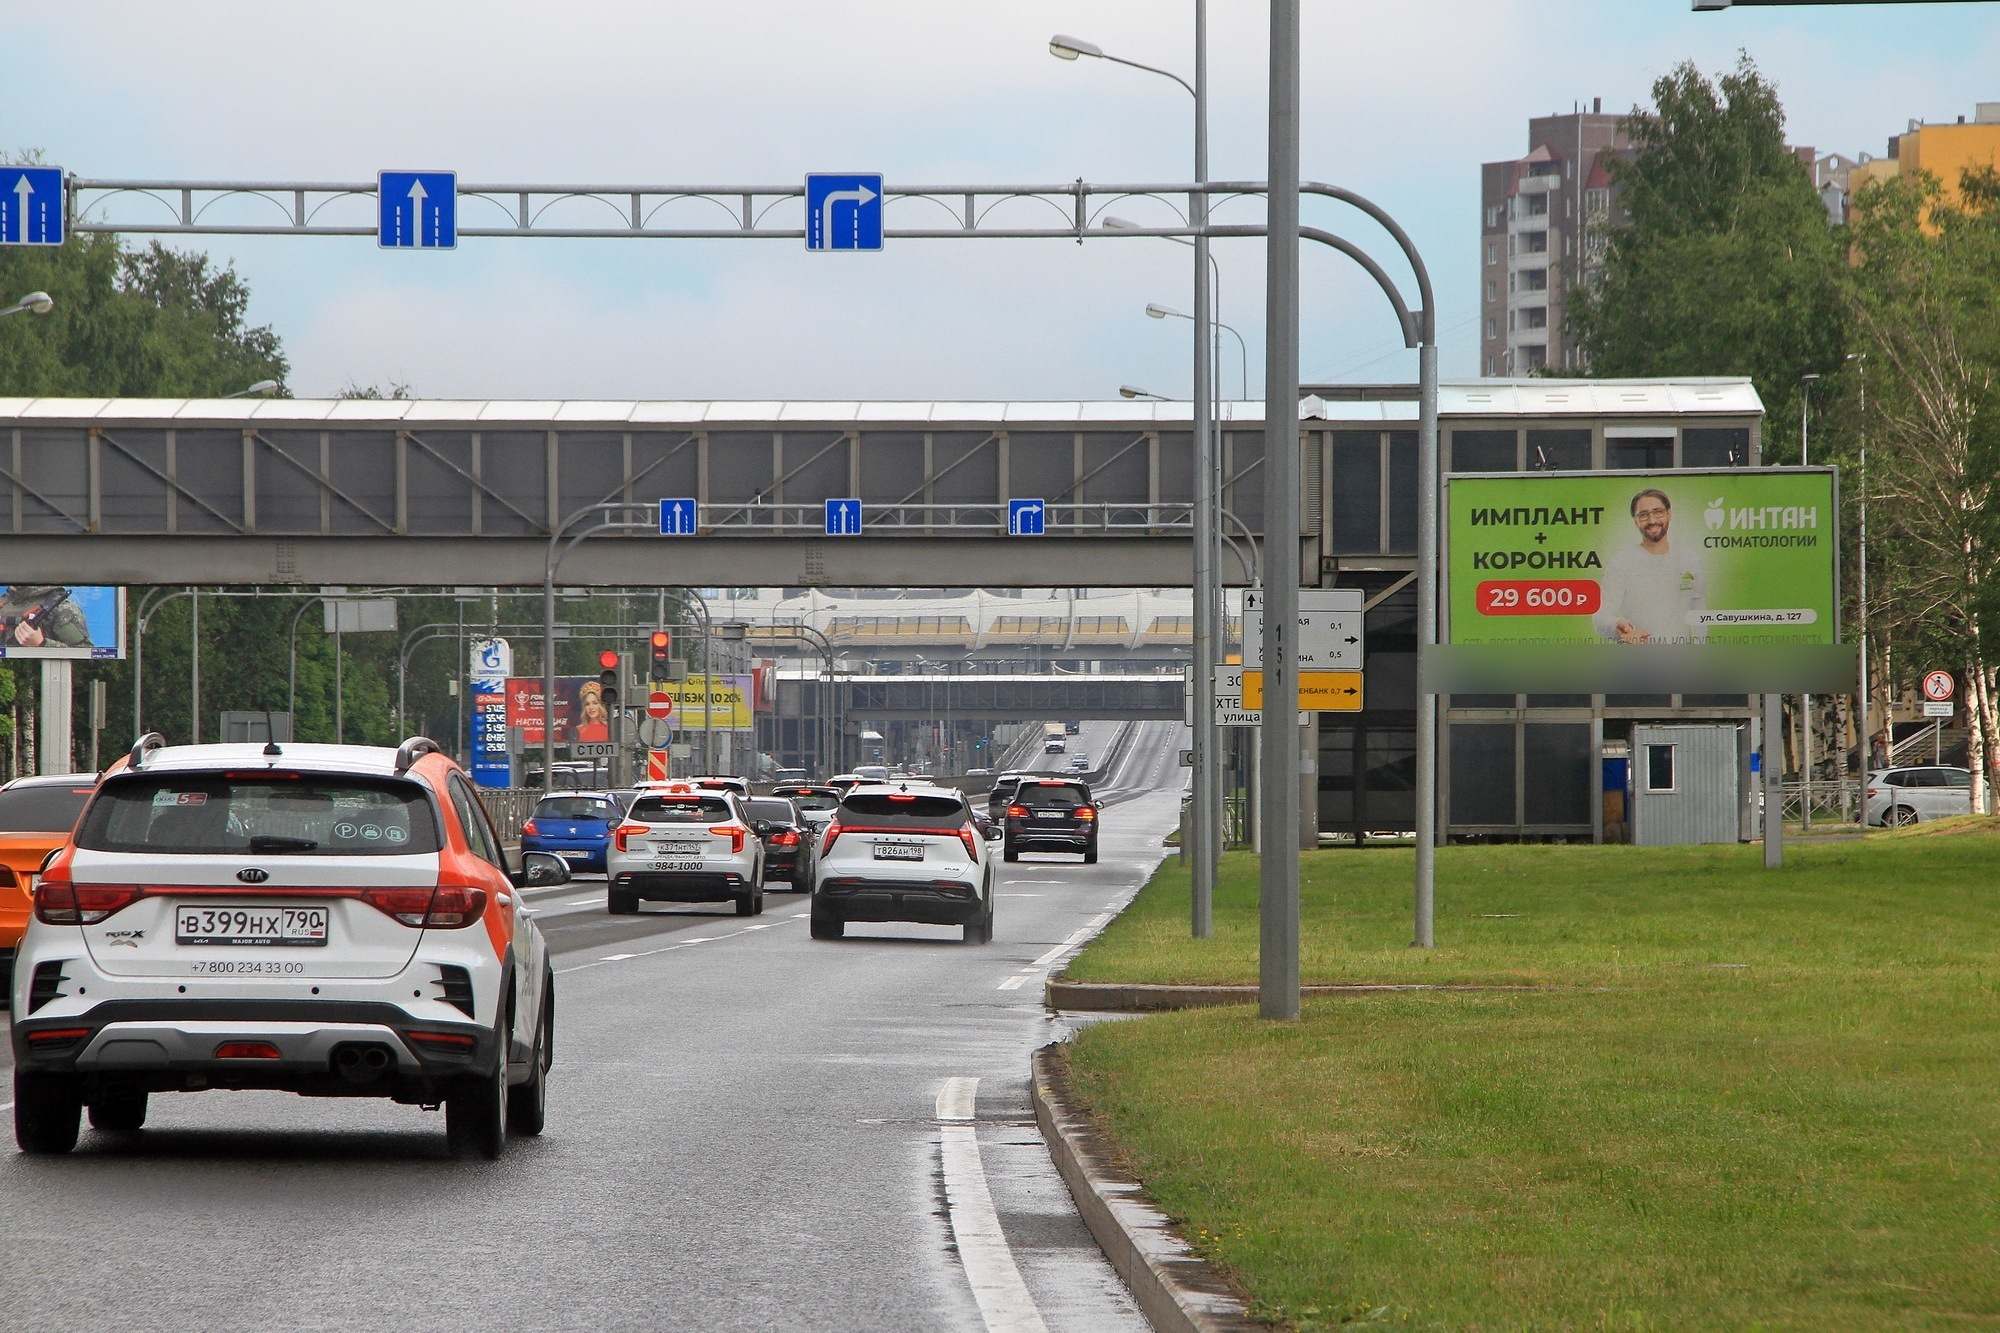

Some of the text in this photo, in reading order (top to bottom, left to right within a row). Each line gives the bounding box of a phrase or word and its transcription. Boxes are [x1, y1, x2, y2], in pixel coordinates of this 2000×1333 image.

[1471, 507, 1604, 526] ИМПЛАНТ
[1730, 506, 1817, 530] ИНТАН
[1704, 535, 1817, 548] СТОМАТОЛОГИИ
[1473, 551, 1602, 570] КОРОНКА
[1490, 588, 1519, 607] 29
[1526, 588, 1573, 607] 600
[1700, 612, 1802, 623] ул. Савушкина, д. 127
[1330, 622, 1342, 631] 0,1
[1329, 651, 1342, 659] 0,5
[1223, 713, 1261, 724] улица
[577, 744, 614, 756] СТОП
[655, 861, 703, 870] 984-1000
[285, 911, 321, 929] 790
[192, 961, 304, 973] +7 800 234 33 00
